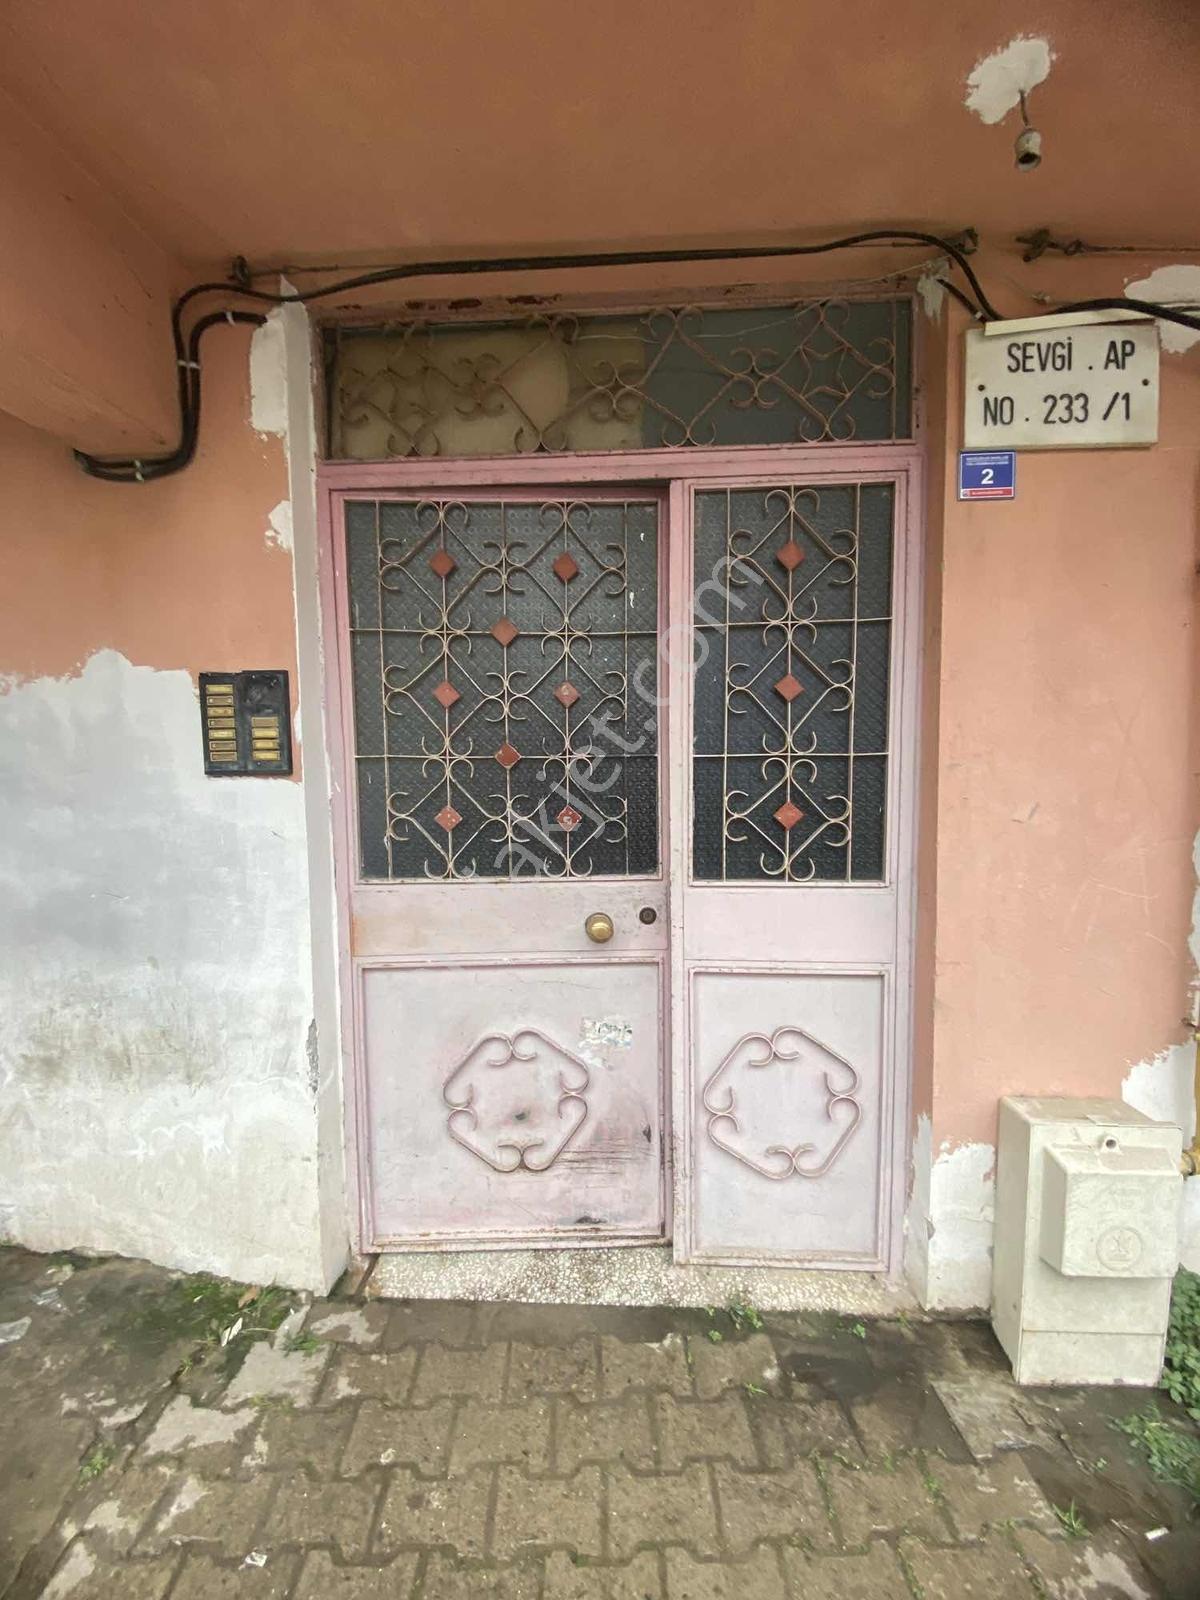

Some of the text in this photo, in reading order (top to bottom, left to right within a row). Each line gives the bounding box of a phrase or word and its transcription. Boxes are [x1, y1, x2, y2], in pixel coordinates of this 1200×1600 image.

[1006, 336, 1073, 373] SEVGİ
[1103, 340, 1136, 371] AP
[980, 468, 994, 485] 2
